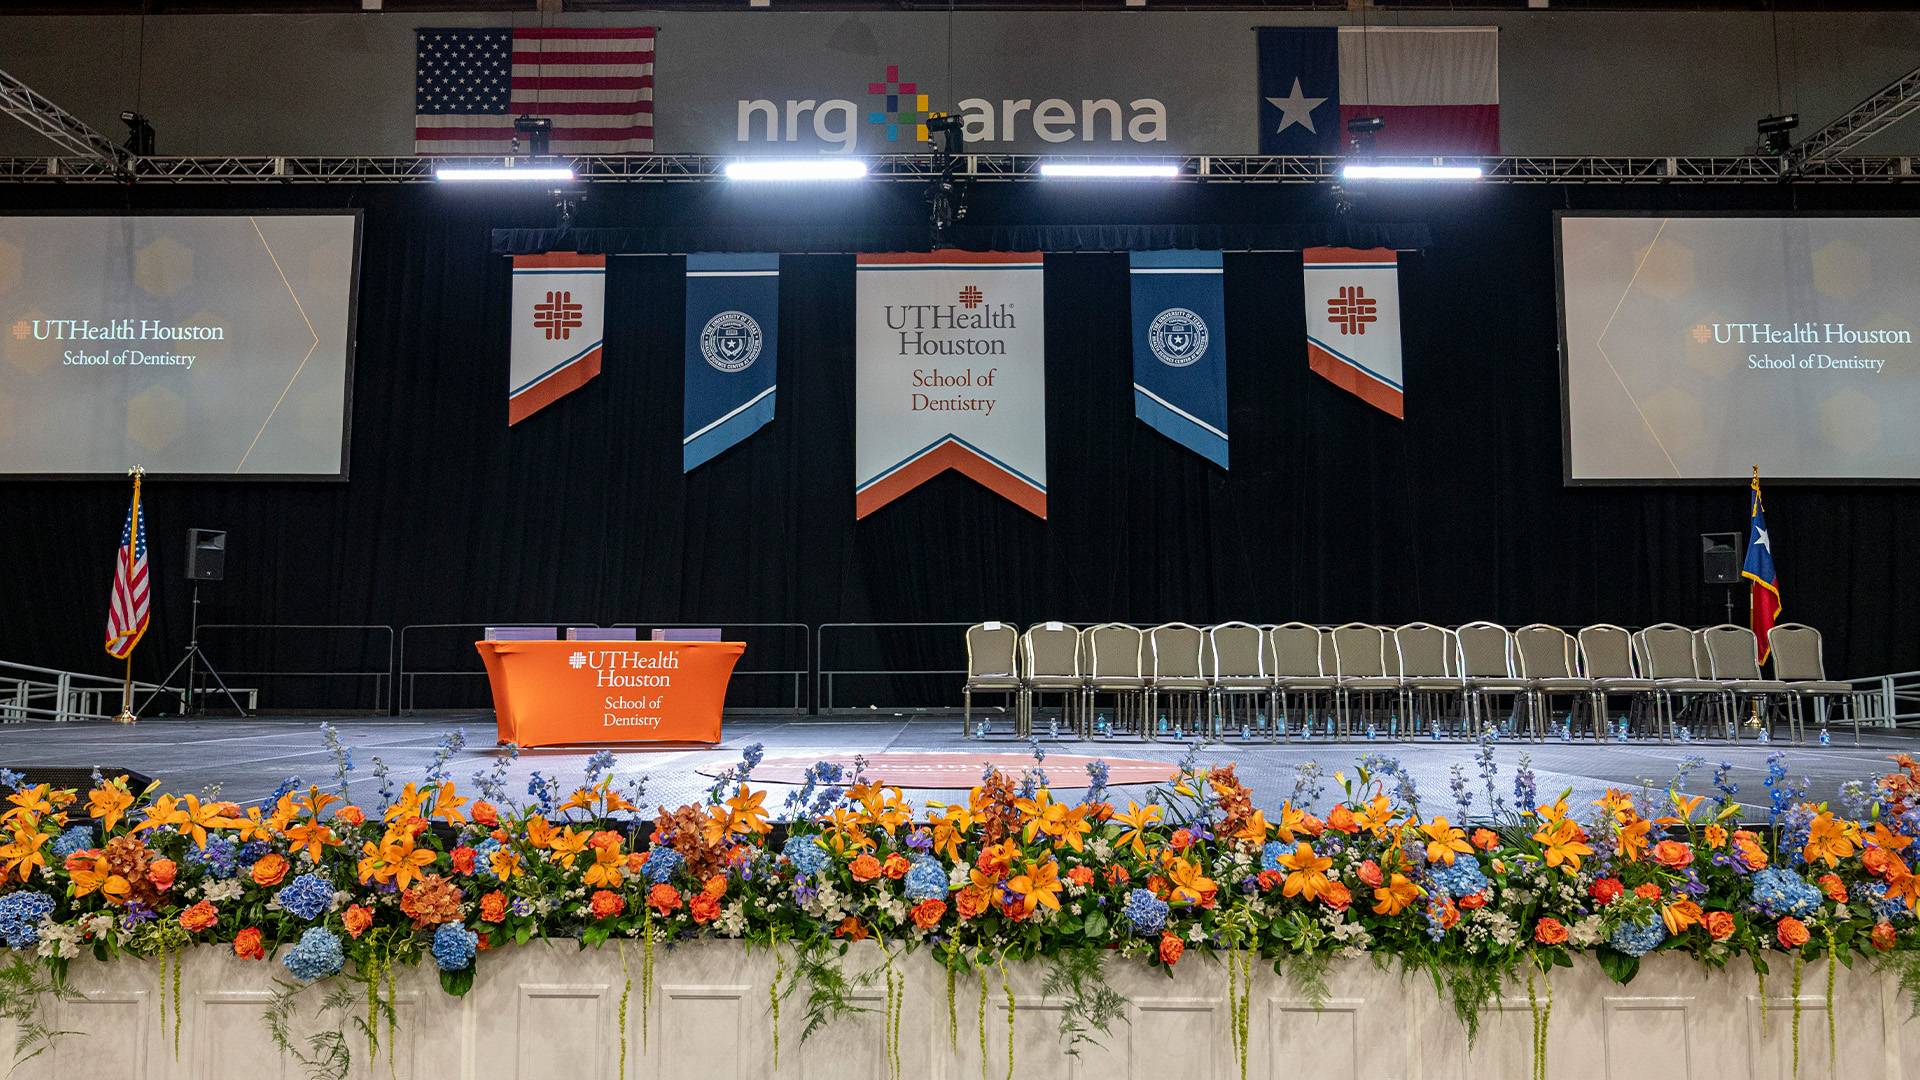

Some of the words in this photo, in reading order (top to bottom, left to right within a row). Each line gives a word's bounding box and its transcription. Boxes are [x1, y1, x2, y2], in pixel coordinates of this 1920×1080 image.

[737, 98, 858, 155] nrg
[958, 97, 1168, 143] arena
[139, 319, 224, 340] Houston
[1824, 323, 1912, 344] Houston
[899, 331, 1006, 356] Houston
[63, 350, 109, 366] School
[112, 350, 130, 366] of
[130, 350, 196, 369] Dentistry
[1748, 354, 1796, 369] School
[1799, 354, 1816, 369] of
[1816, 354, 1885, 373] Dentistry
[912, 368, 972, 387] School
[976, 367, 998, 387] of
[911, 393, 997, 417] Dentistry
[596, 669, 670, 687] Houston
[604, 696, 646, 710] School
[648, 695, 664, 709] of
[603, 713, 662, 730] Dentistry
